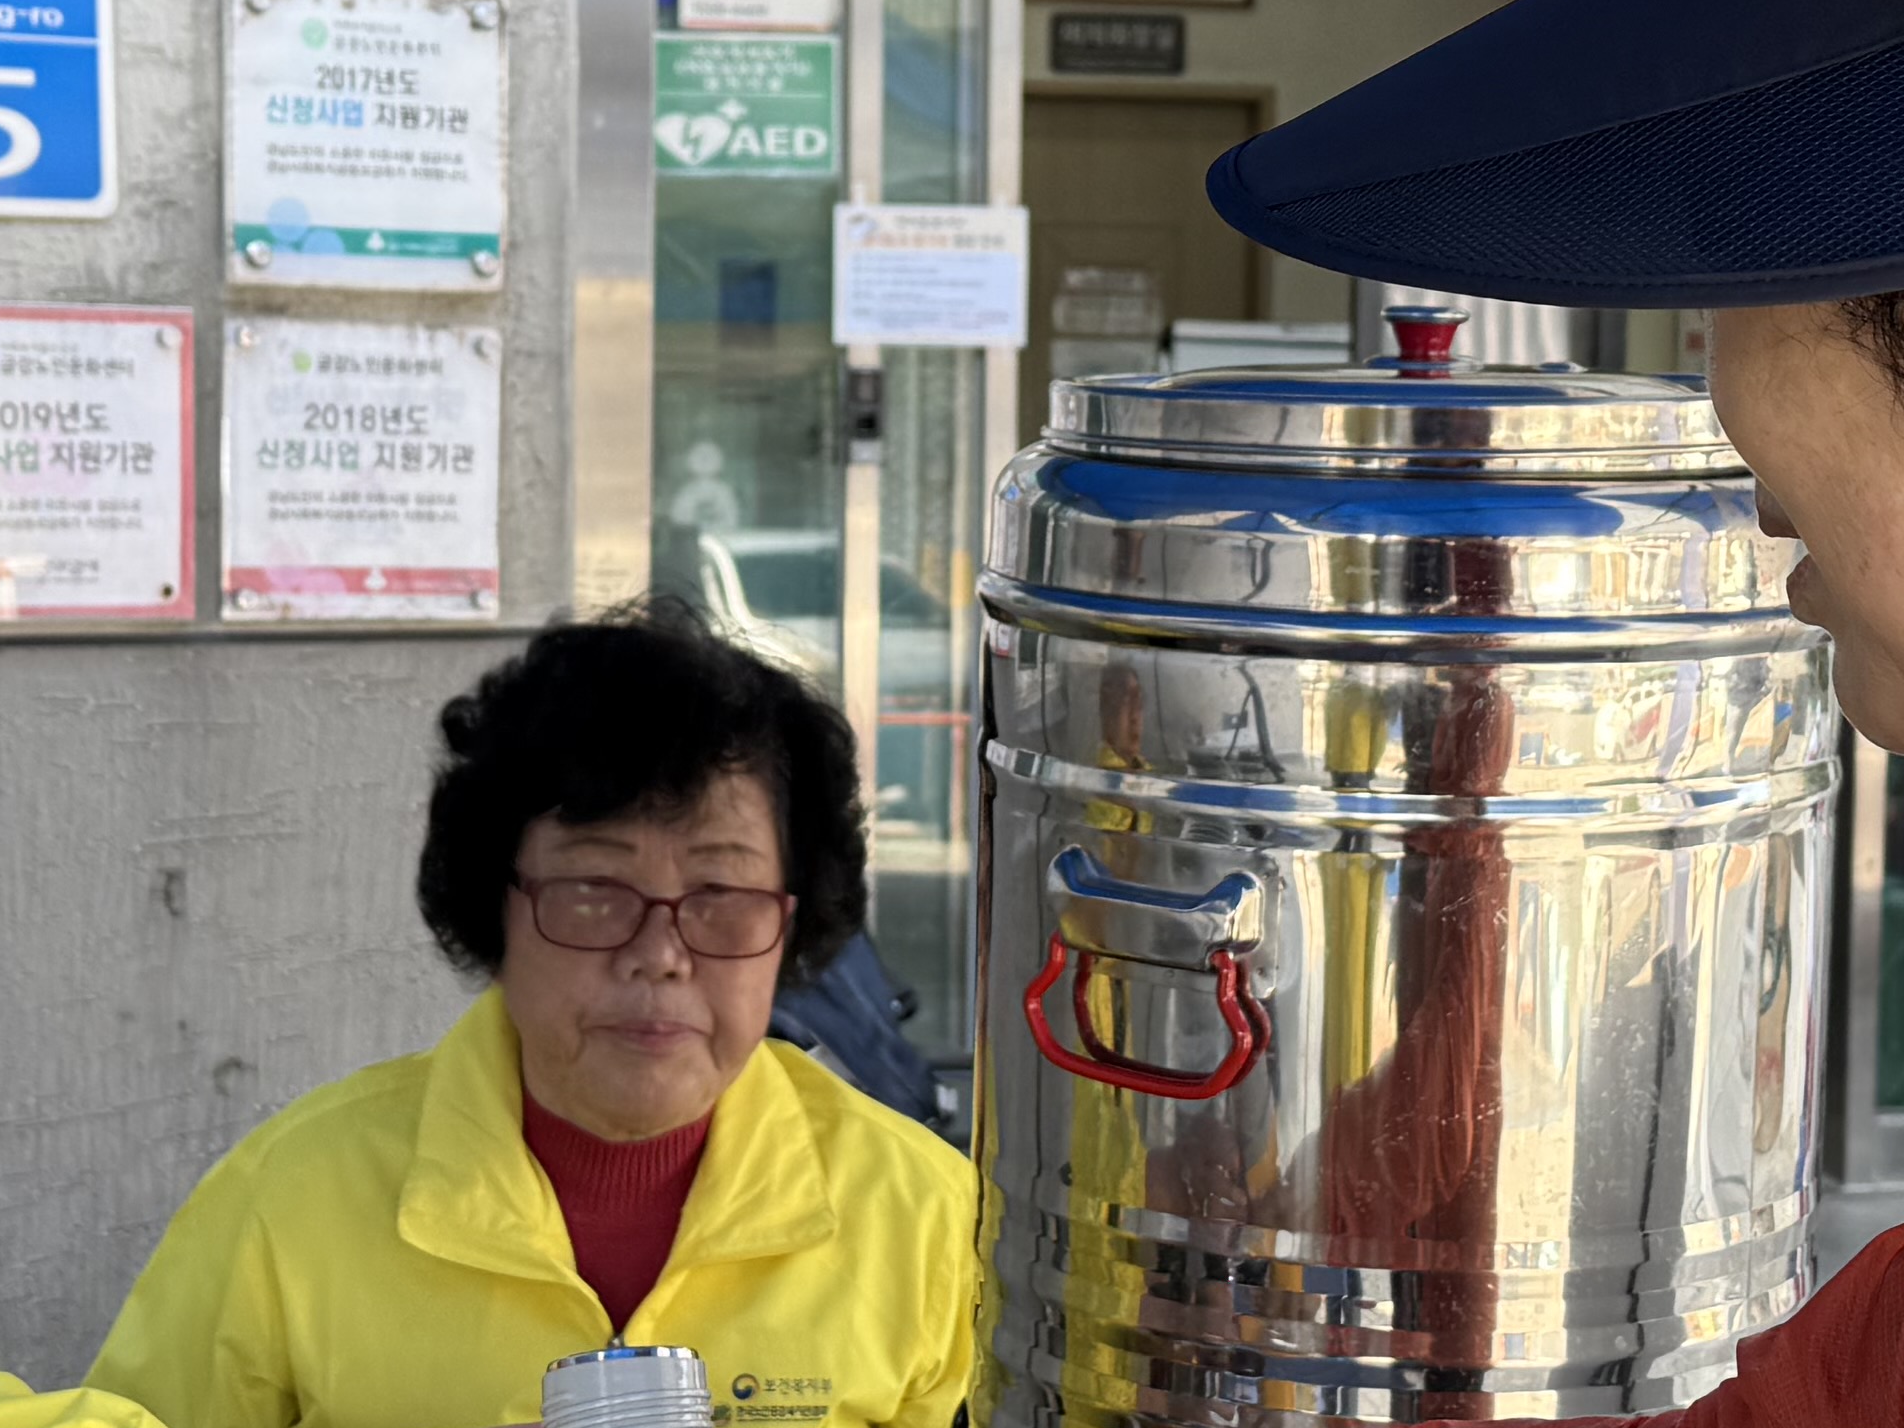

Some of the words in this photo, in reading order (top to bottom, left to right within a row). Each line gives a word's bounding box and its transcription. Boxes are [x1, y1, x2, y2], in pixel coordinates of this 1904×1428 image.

[315, 64, 420, 96] 2017년도
[727, 125, 828, 157] AED
[303, 401, 429, 436] 2018년도
[48, 440, 155, 475] 지원기관
[373, 441, 476, 474] 지원기관
